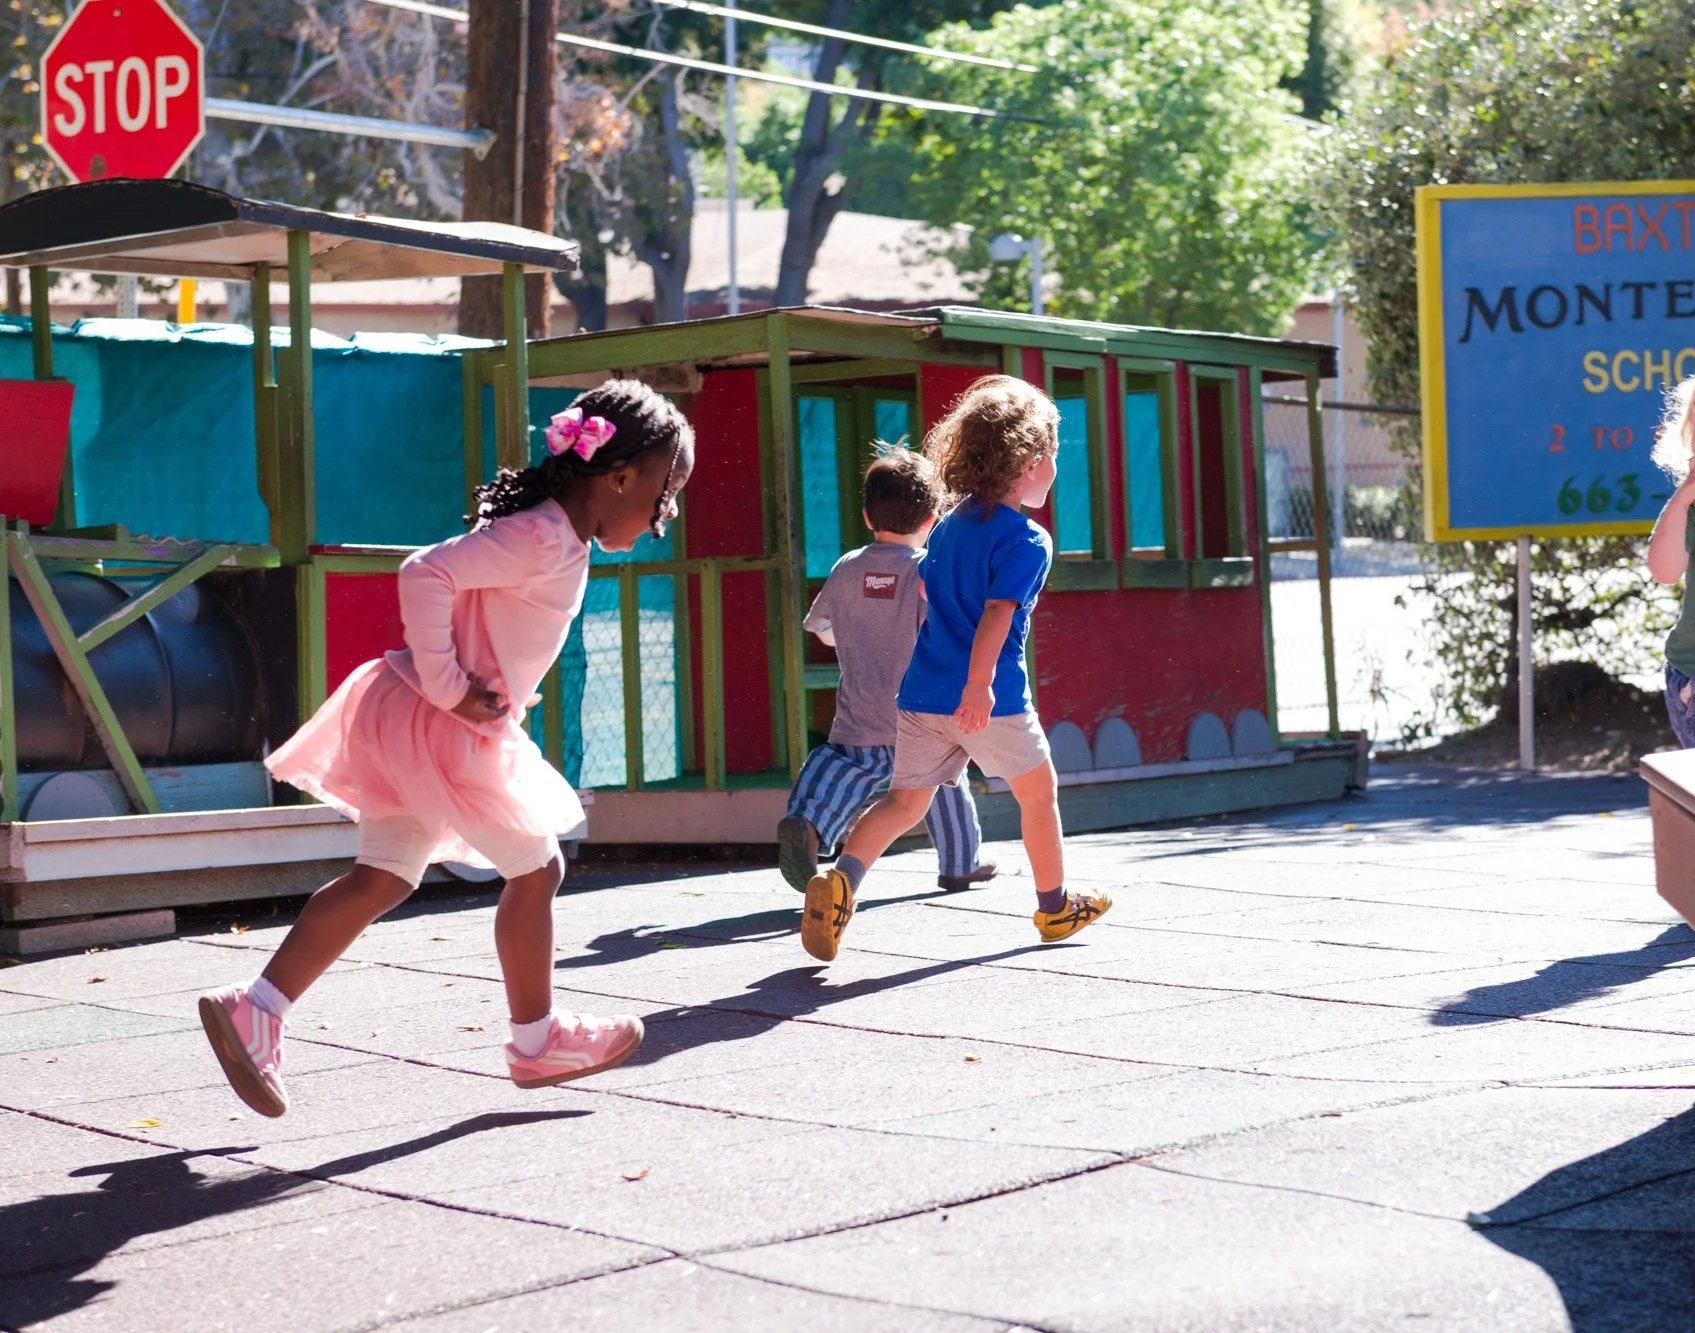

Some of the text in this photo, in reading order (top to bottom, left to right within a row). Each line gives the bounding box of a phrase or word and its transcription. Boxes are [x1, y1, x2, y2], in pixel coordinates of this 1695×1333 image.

[54, 55, 190, 137] STOP
[1574, 202, 1695, 254] BAXT
[1459, 280, 1695, 343] MONTE
[1549, 424, 1566, 452] 2
[1591, 426, 1634, 450] TO
